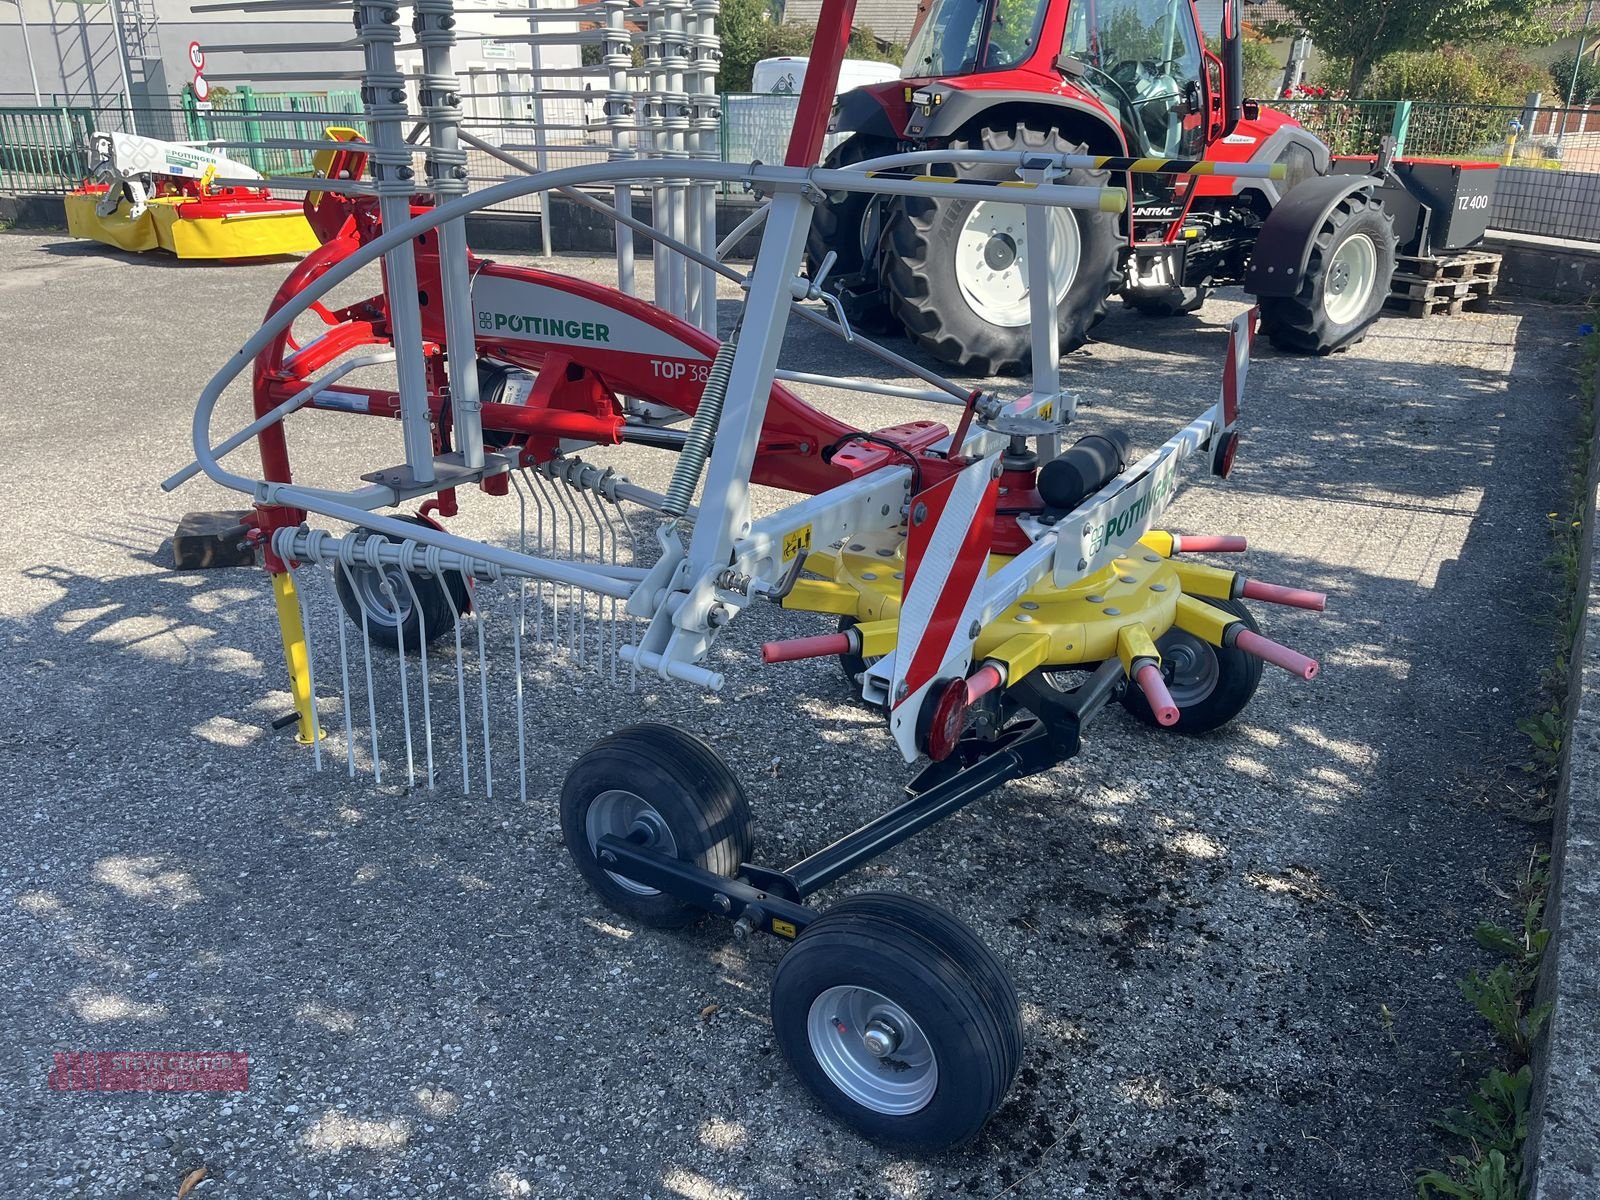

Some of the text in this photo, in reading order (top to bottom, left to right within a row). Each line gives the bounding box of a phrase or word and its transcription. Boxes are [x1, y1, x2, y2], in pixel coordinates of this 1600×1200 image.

[1458, 195, 1488, 210] TZ 400
[650, 359, 713, 383] TOP 38
